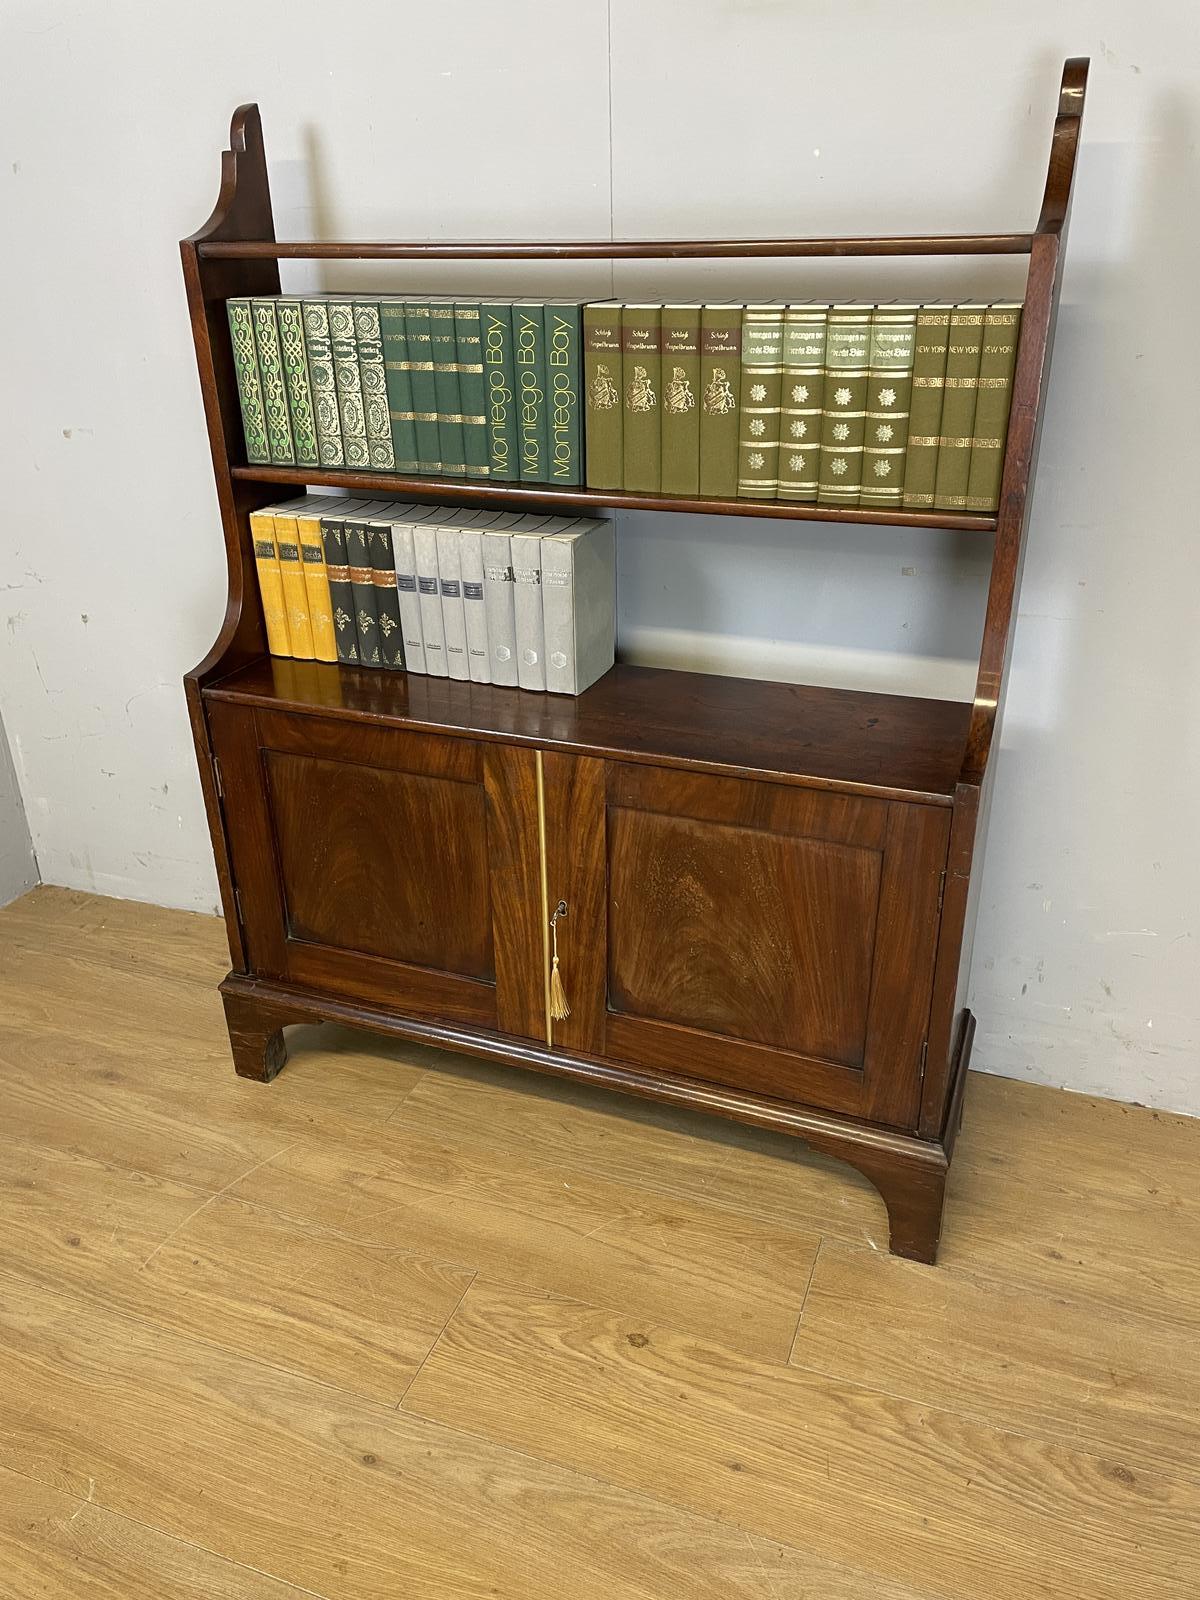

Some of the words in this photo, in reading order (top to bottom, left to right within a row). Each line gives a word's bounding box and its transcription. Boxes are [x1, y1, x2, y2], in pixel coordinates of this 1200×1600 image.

[486, 314, 507, 364] Bay
[518, 314, 539, 364] Bay
[550, 315, 574, 366] Bay
[949, 345, 965, 353] NEW
[489, 371, 512, 473] Montego
[520, 371, 544, 474] Montego
[553, 373, 576, 477] Montego
